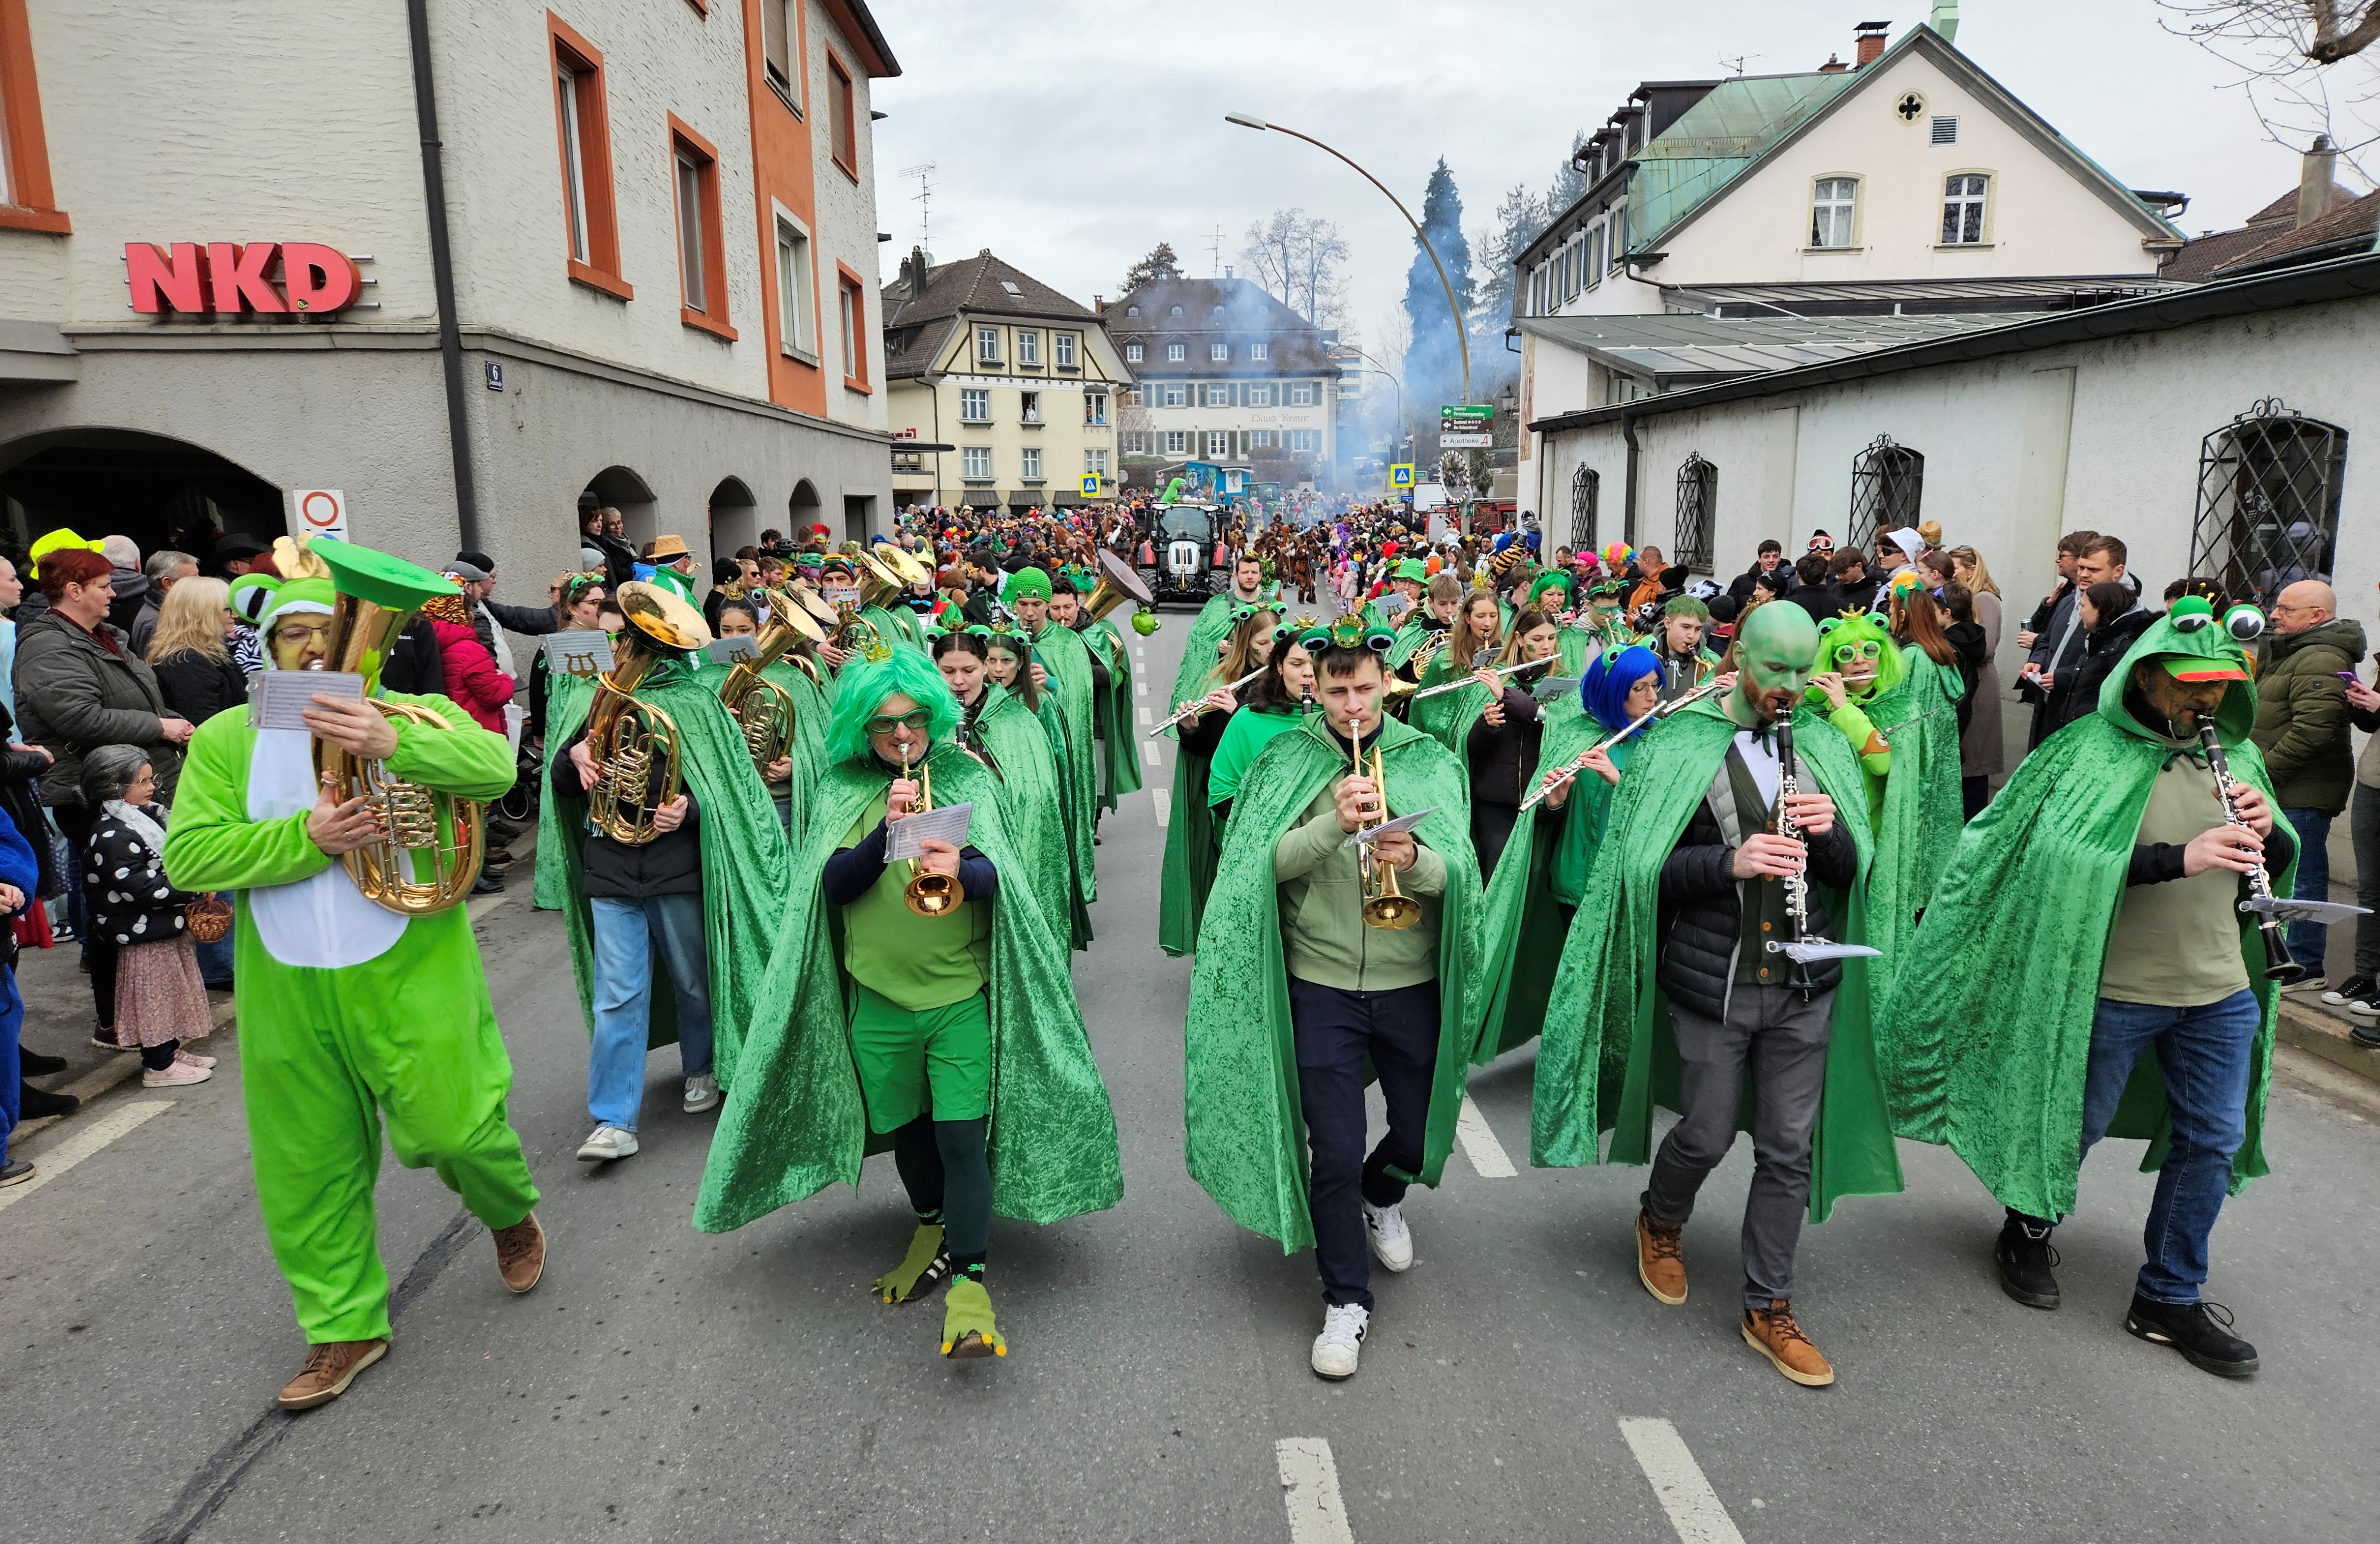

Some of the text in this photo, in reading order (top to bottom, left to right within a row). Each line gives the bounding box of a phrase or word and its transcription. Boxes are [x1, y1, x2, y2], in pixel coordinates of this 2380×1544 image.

[125, 242, 357, 313] NKD
[493, 365, 498, 380] 6
[1251, 413, 1311, 422] Haus Reiner
